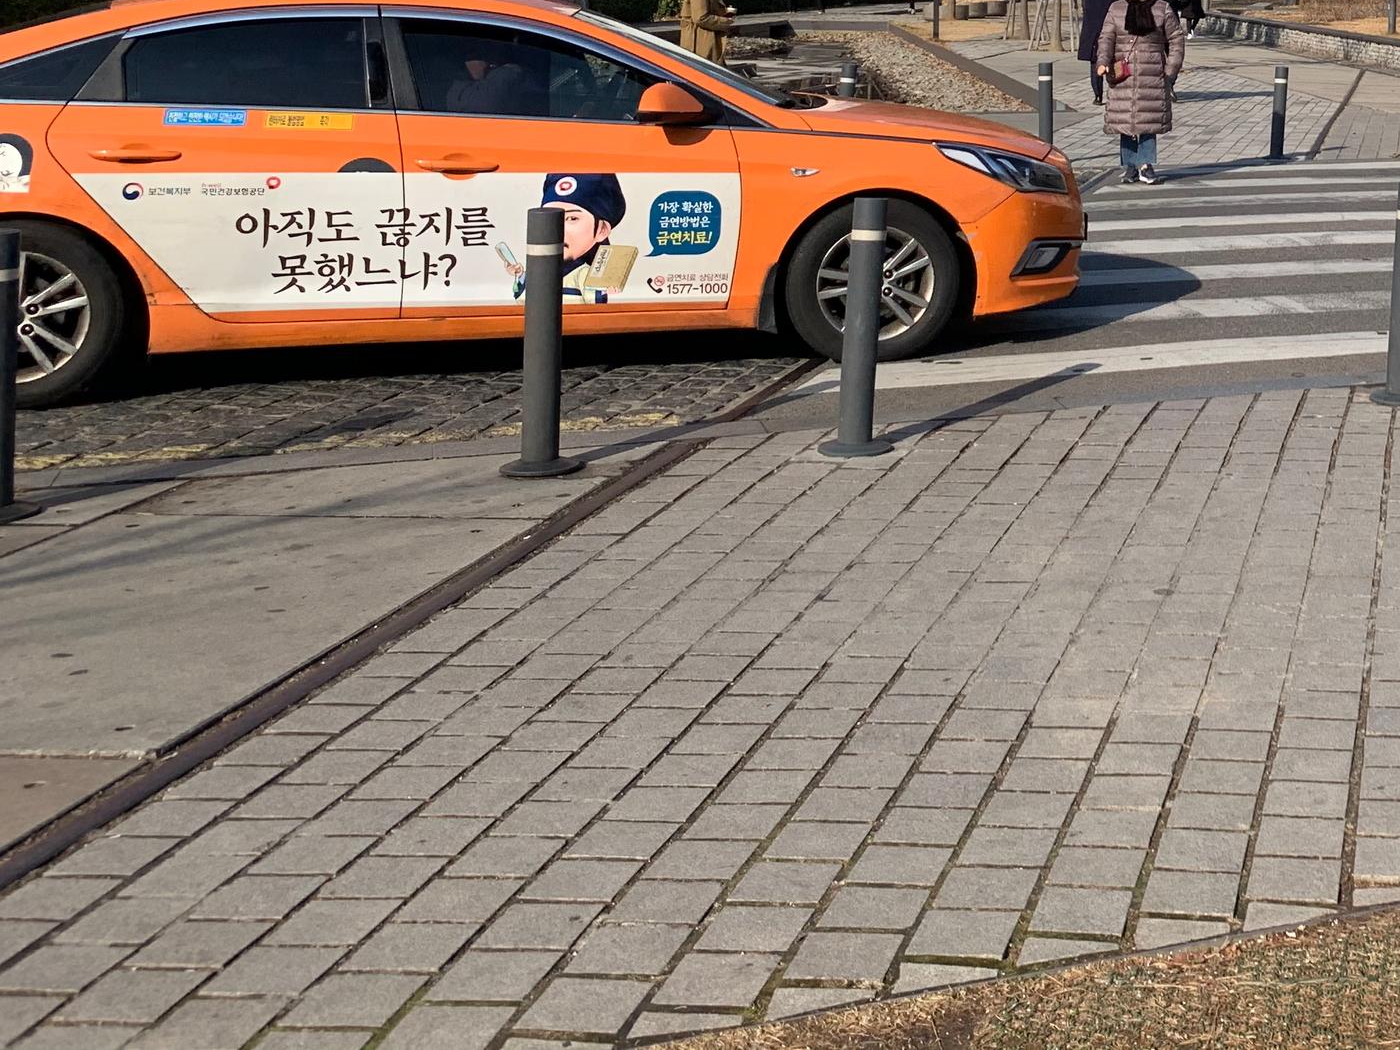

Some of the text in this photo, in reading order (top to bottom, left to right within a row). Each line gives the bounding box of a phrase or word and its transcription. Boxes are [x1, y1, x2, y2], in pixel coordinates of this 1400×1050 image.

[148, 187, 191, 196] 보건복지부
[201, 187, 265, 196] 국민건강보험공단
[658, 201, 714, 214] 가장 확실한
[235, 206, 495, 248] 아직도 끊지를
[659, 216, 711, 228] 금연방법은
[656, 231, 713, 246] 금연치료!
[271, 252, 457, 294] 못했느냐?
[667, 273, 729, 282] 금연치료 상담전화
[667, 283, 728, 294] 1577-1000
